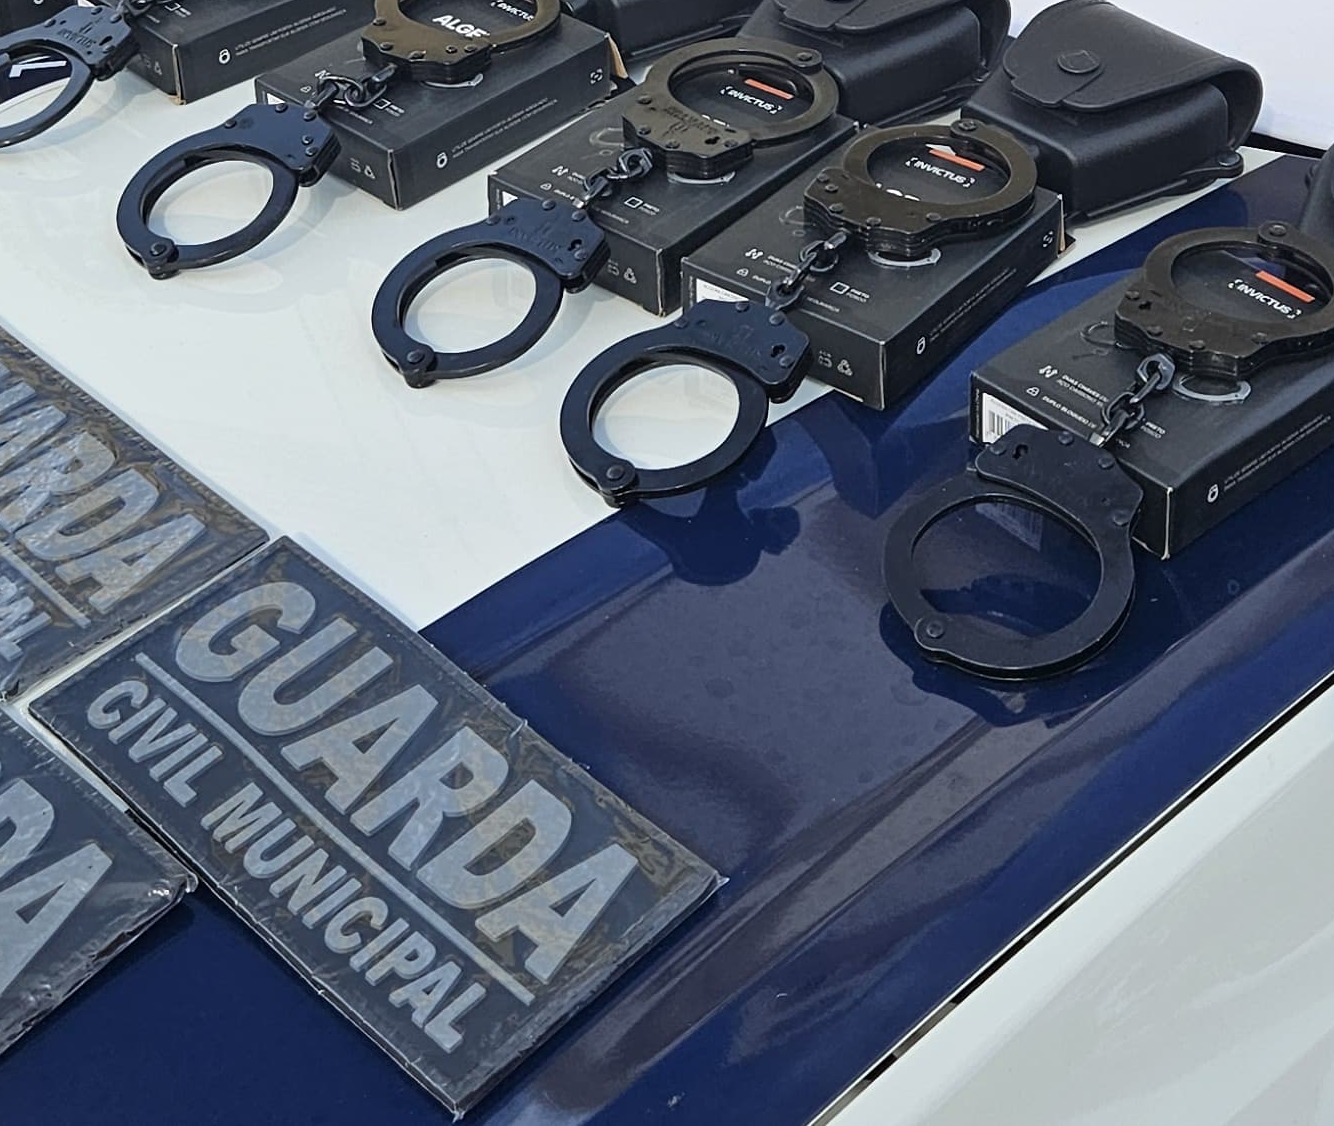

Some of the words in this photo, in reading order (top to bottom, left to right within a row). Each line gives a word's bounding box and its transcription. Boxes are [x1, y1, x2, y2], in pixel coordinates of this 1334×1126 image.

[914, 159, 967, 186] INVICTUS
[1236, 281, 1294, 316] INVICTUS
[85, 677, 224, 804] CIVIL
[201, 777, 494, 1054] MUNICIPAL
[173, 571, 639, 986] GUARDA
